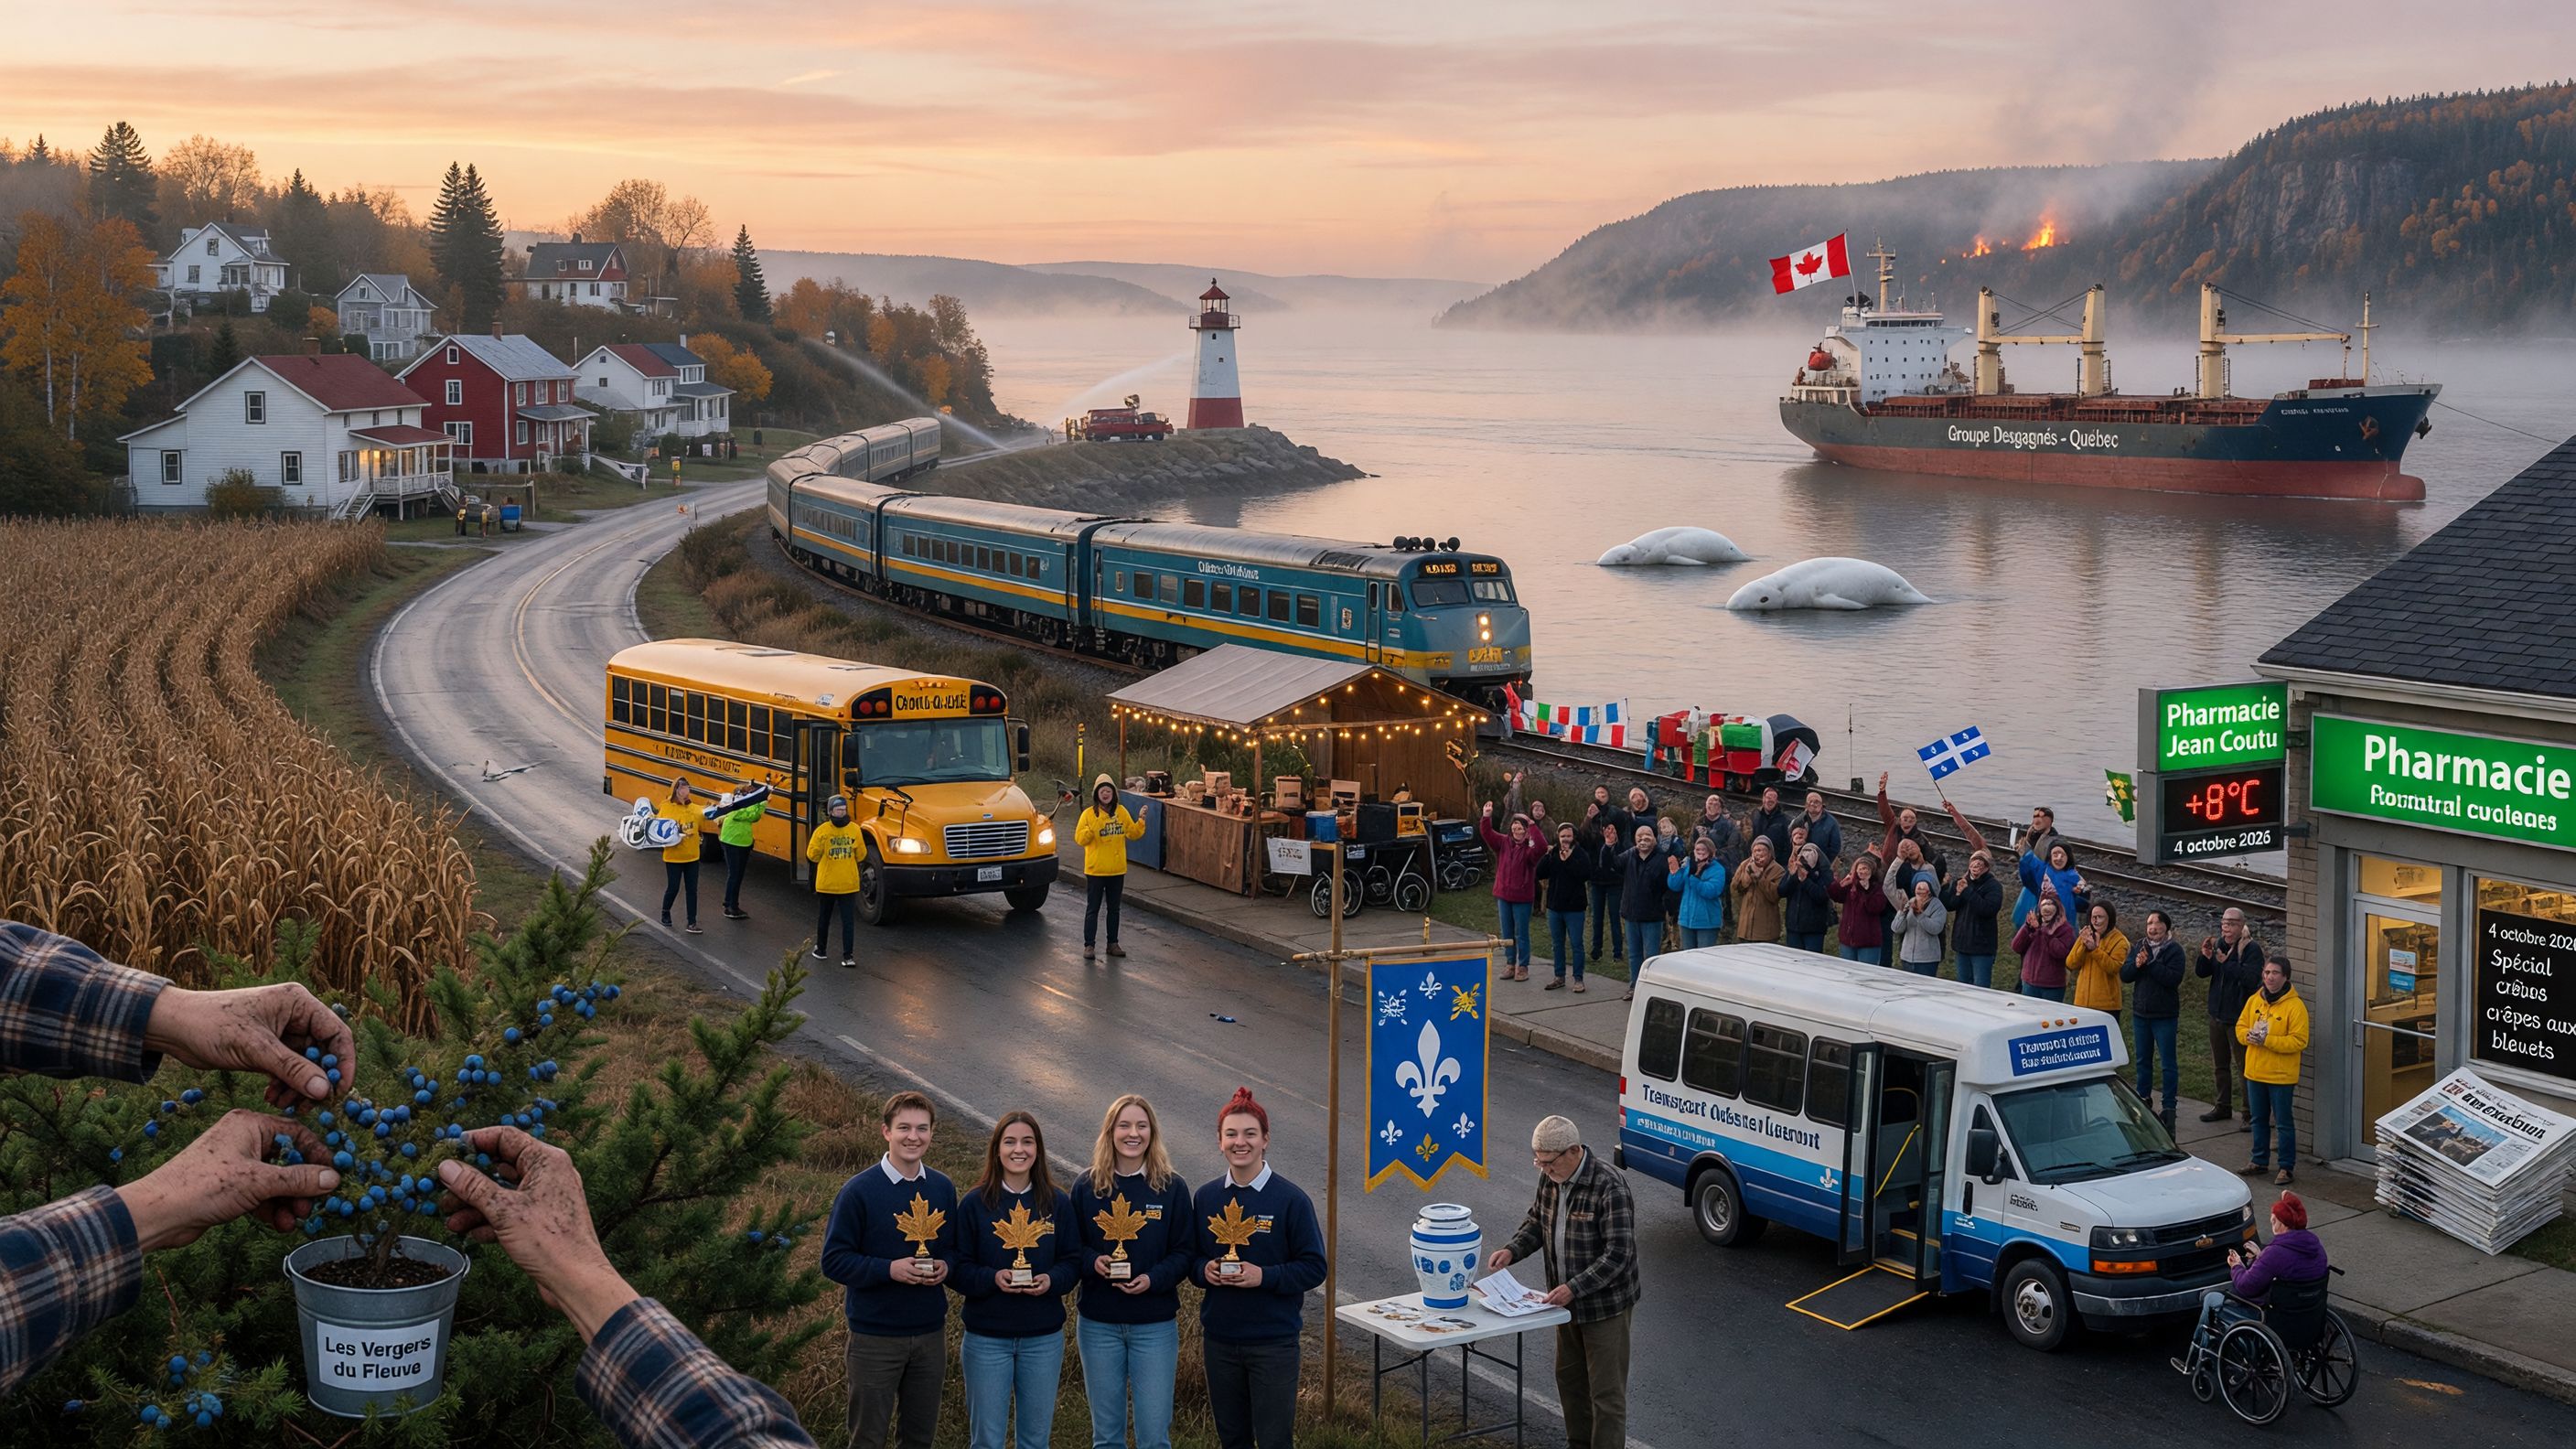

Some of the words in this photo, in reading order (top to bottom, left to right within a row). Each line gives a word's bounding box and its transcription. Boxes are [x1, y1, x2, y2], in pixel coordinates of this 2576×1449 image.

[1948, 424, 1990, 447] Groupe
[1993, 425, 2058, 450] Desgagnés
[2069, 429, 2119, 451] Québec
[2167, 695, 2281, 727] Pharmacie
[2166, 735, 2215, 757] Jean
[2220, 729, 2278, 752] Coutu
[2364, 735, 2571, 800] Pharmacie
[2185, 779, 2260, 821] +8°C
[2174, 840, 2184, 855] 4
[2186, 835, 2237, 853] octobre
[2239, 830, 2271, 847] 2026
[2488, 923, 2497, 939] 4
[2500, 928, 2547, 947] octobre
[2491, 949, 2553, 977] Spécial
[2492, 1029, 2555, 1059] bleuets
[326, 1336, 356, 1357] Les
[361, 1337, 431, 1359] Vergers
[334, 1361, 356, 1378] du
[363, 1362, 421, 1379] Fleuve
